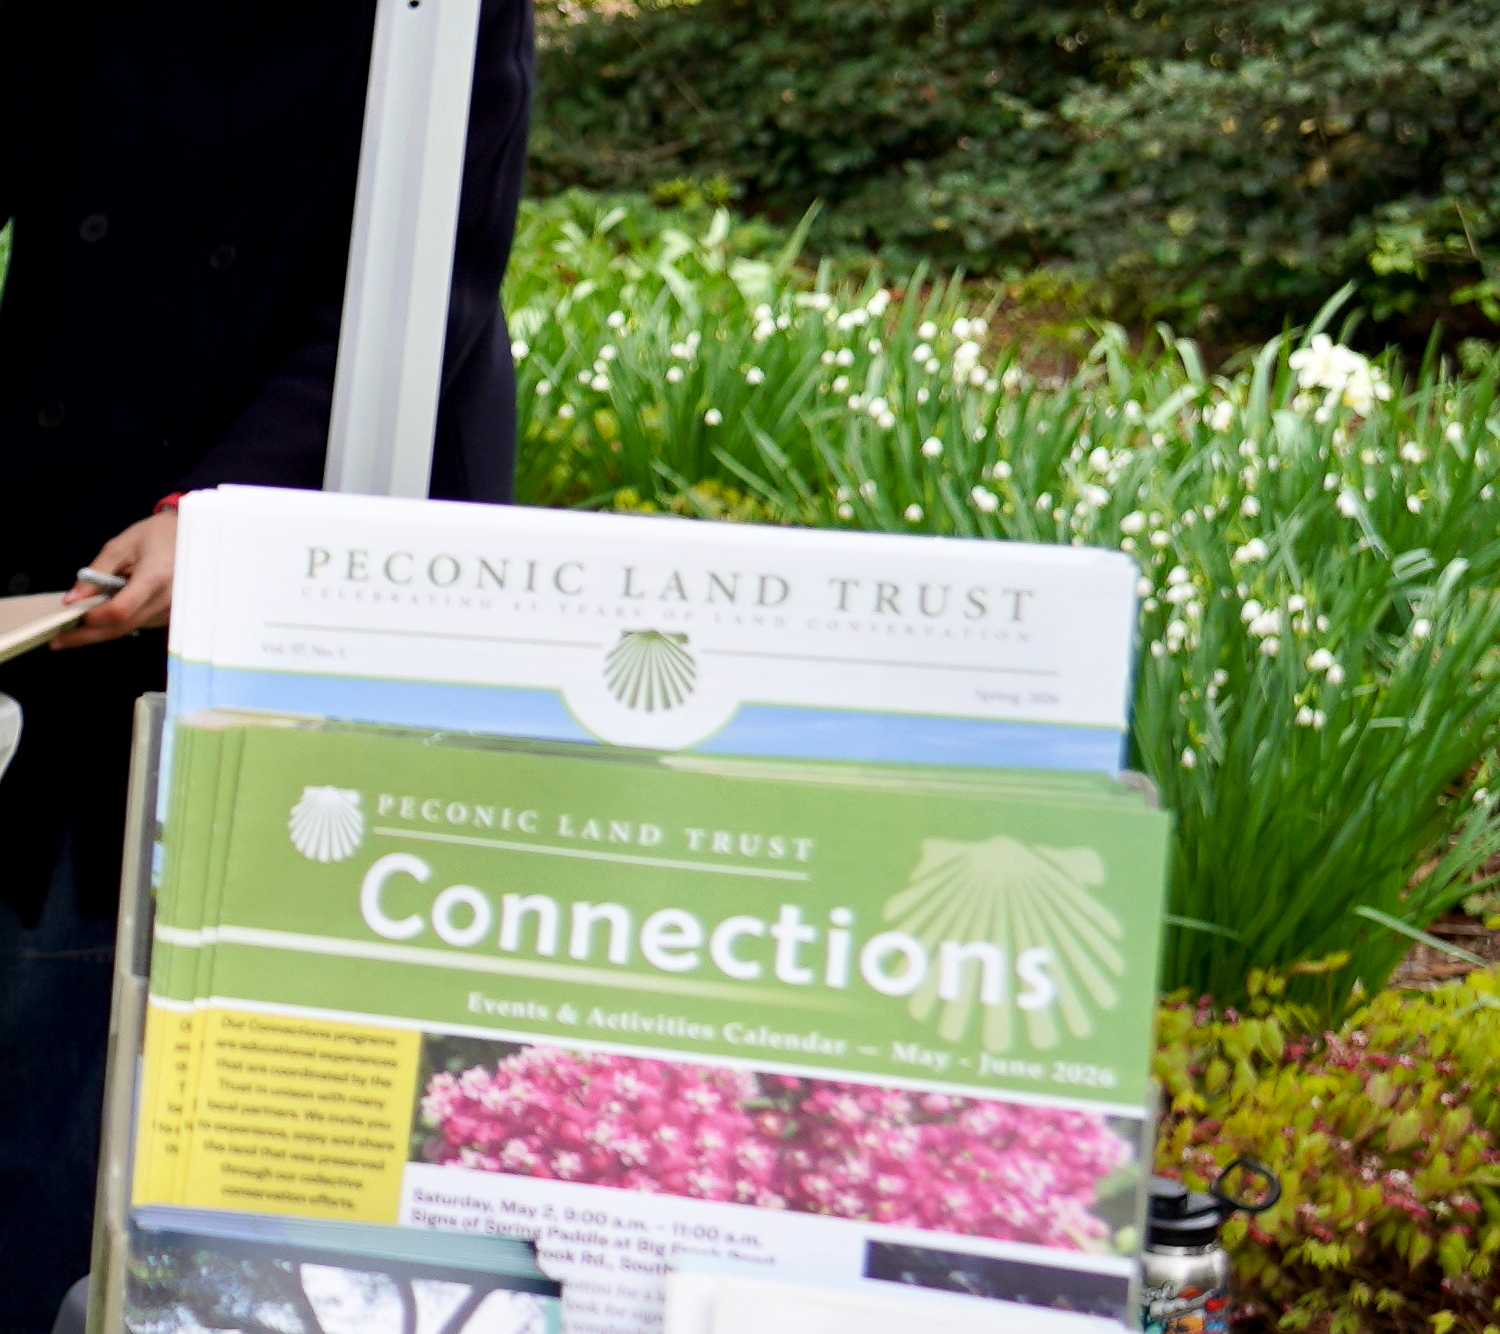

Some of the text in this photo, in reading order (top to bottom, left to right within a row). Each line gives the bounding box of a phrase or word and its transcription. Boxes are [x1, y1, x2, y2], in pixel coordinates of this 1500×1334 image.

[304, 546, 1037, 624] PECONIC LAND TRUST
[713, 611, 786, 629] LAND
[377, 793, 815, 863] PECONIC LAND TRUST
[360, 853, 1059, 1012] Connections
[466, 990, 555, 1023] Events
[557, 1004, 579, 1026] &
[587, 1005, 715, 1044] Activities
[722, 1021, 846, 1059] Calendar
[892, 1042, 952, 1070] May
[978, 1051, 1044, 1082] June
[412, 1186, 495, 1216] Saturday,
[500, 1198, 537, 1218] May
[564, 1205, 606, 1227] 9:00
